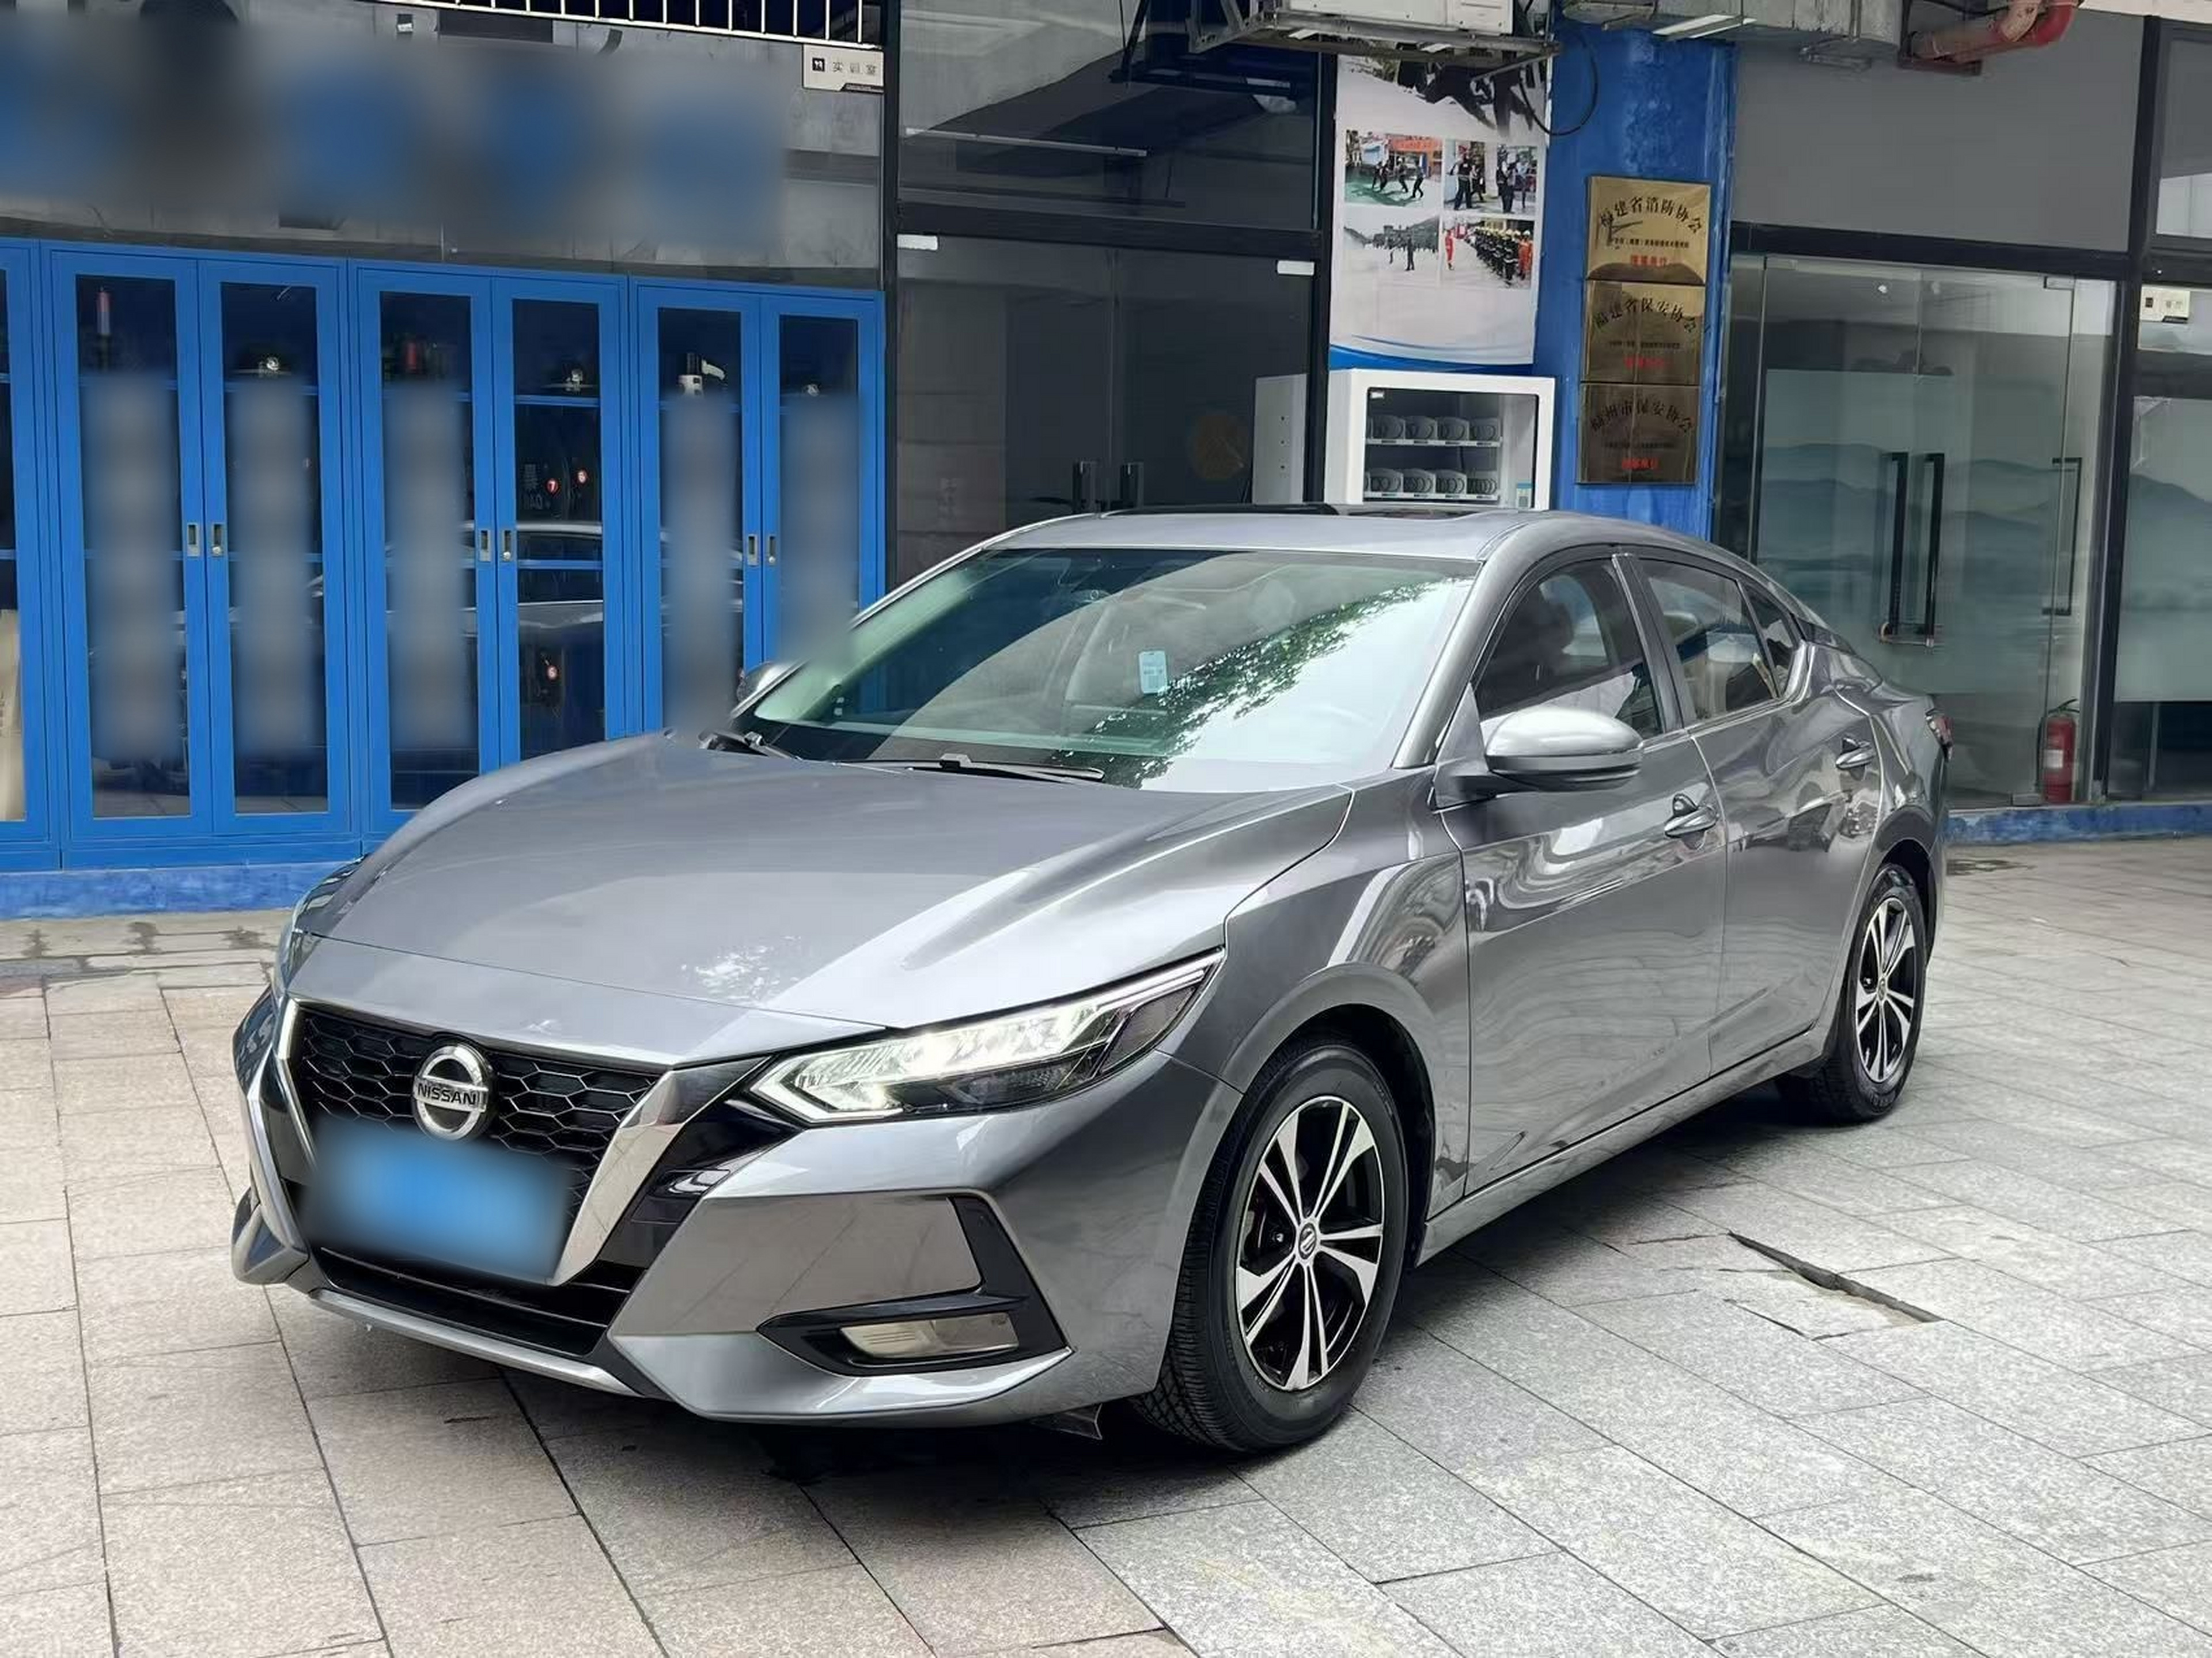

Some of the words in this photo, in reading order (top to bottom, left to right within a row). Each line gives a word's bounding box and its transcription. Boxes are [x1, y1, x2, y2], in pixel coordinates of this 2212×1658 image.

[1599, 196, 1702, 234] 福建省消防协会
[418, 1083, 476, 1105] NISSAN
